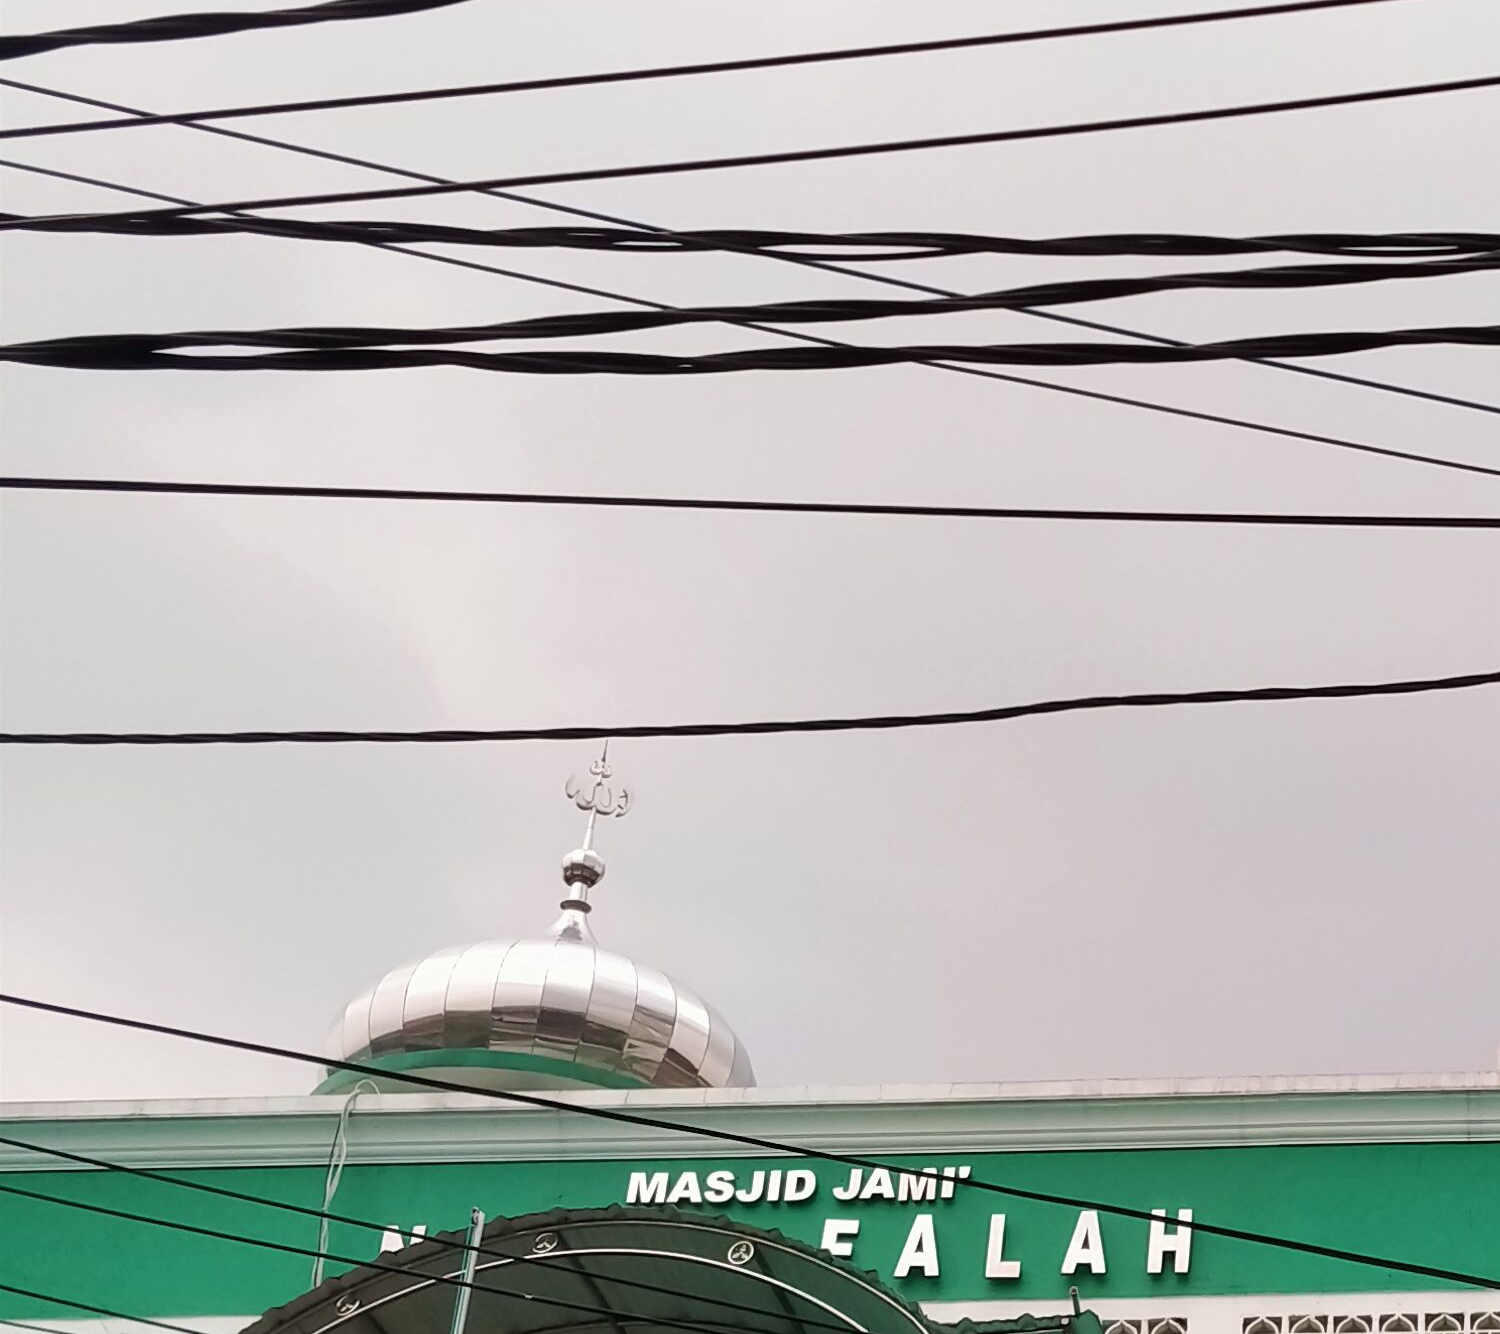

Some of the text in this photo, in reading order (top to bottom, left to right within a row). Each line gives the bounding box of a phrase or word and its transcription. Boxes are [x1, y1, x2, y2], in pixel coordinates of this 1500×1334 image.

[626, 1165, 972, 1204] MASJID JAMI'
[820, 1208, 1193, 1279] FALAH
